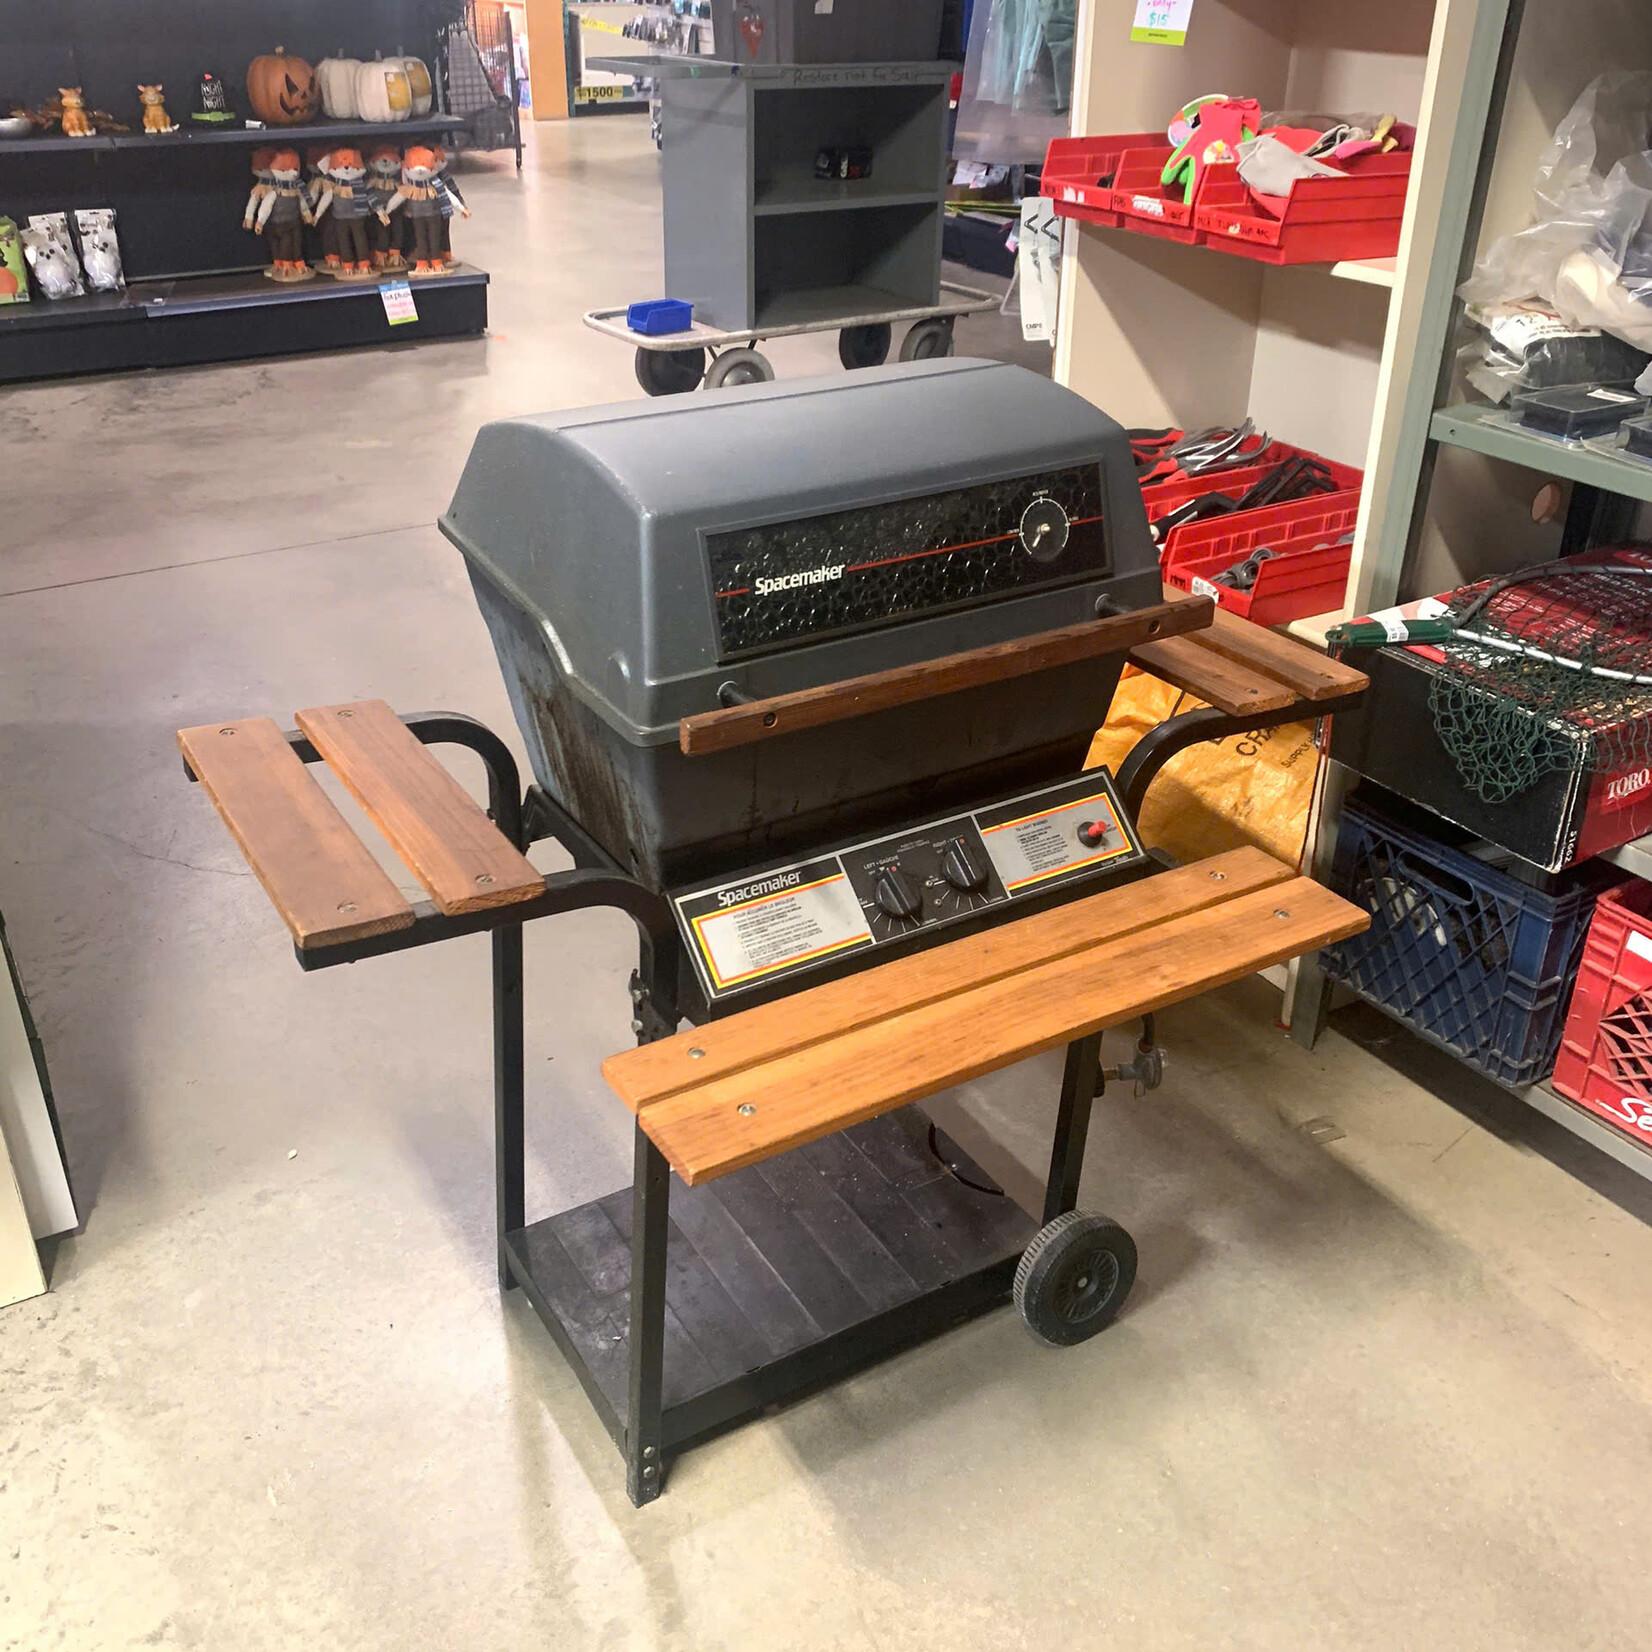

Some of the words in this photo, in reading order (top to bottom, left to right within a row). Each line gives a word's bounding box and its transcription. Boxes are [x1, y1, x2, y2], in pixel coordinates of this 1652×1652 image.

[1149, 11, 1169, 27] $15
[587, 86, 613, 98] 1500
[755, 563, 846, 597] Spacemaker
[1280, 741, 1310, 769] SUPPLY
[1606, 768, 1651, 800] TORO
[717, 871, 802, 907] Spacemaker
